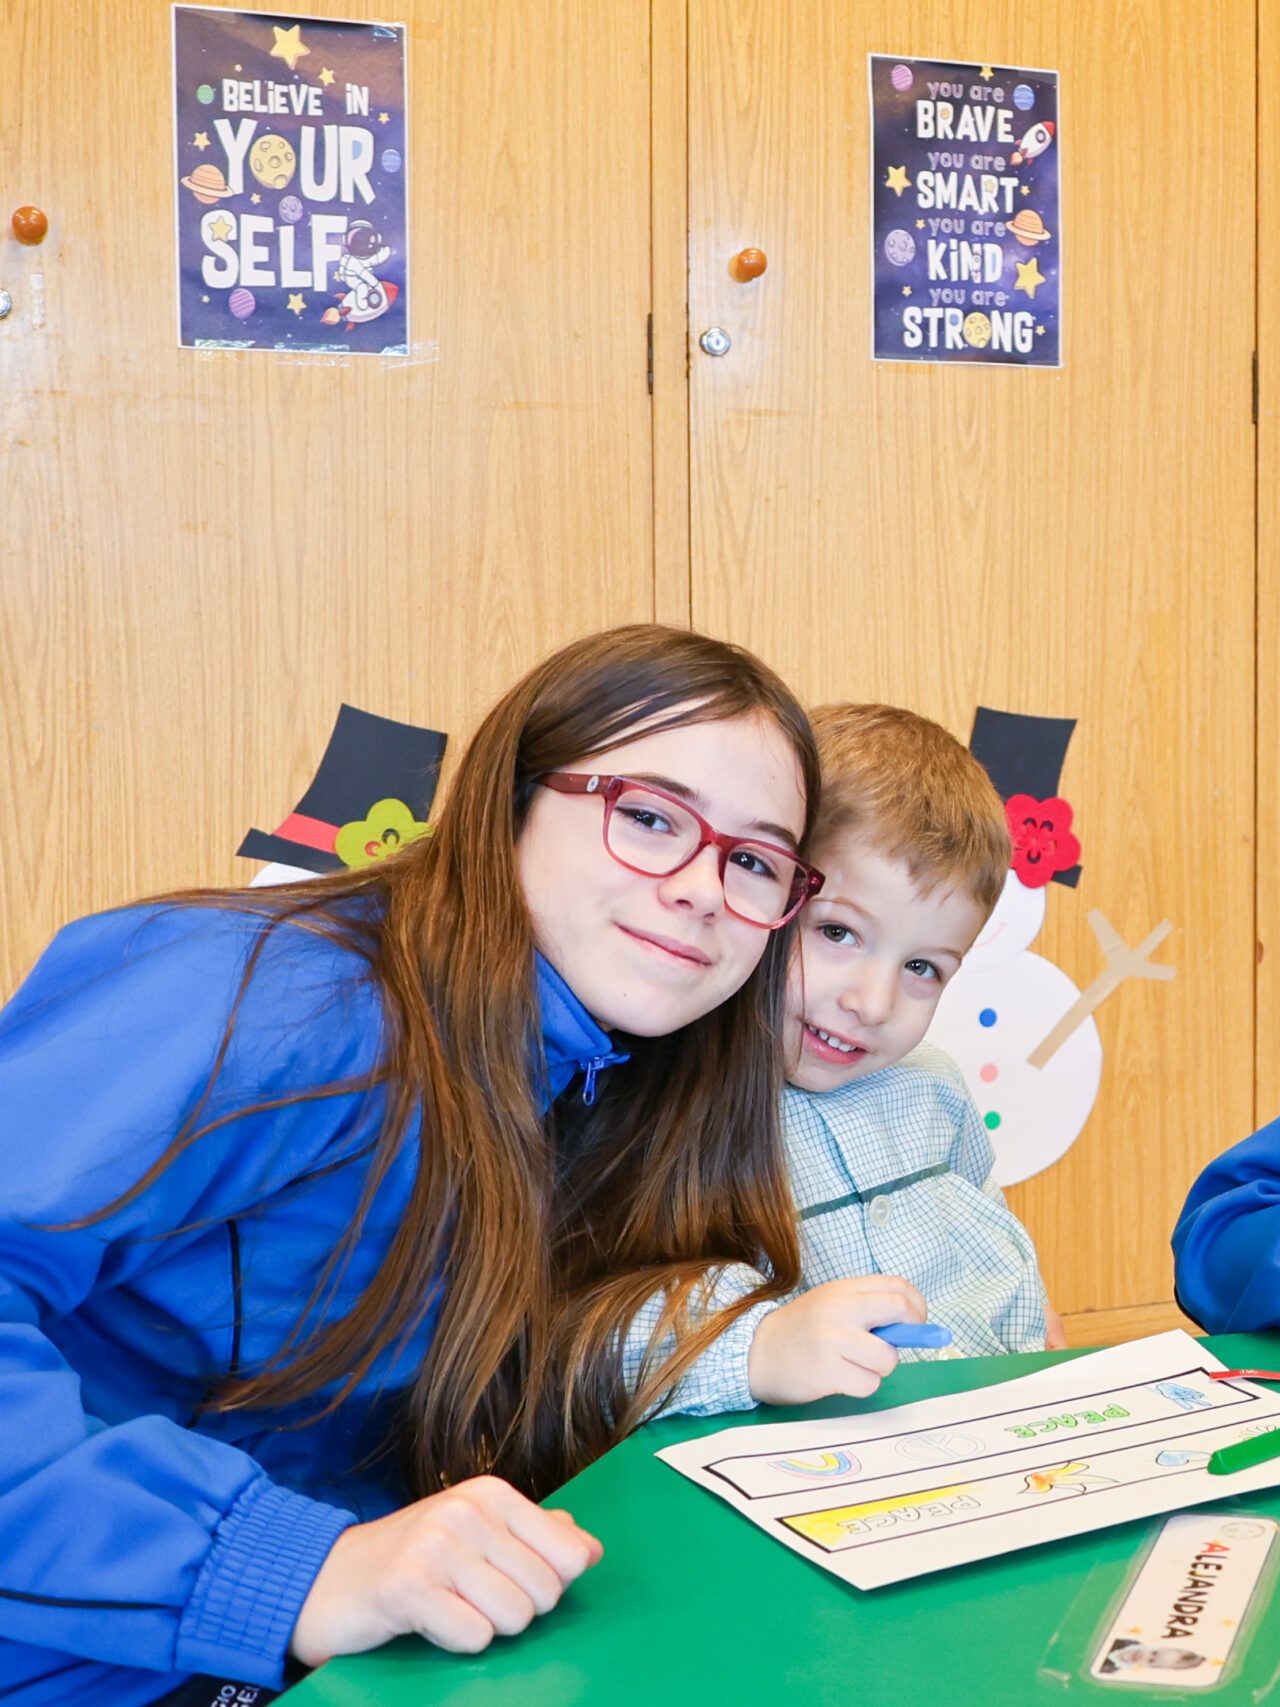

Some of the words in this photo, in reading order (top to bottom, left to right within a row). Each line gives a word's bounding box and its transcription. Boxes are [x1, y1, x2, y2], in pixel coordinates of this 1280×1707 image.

[927, 81, 963, 101] you
[969, 83, 1005, 103] are
[916, 100, 1015, 143] BRAVE
[213, 118, 377, 205] YOUR
[928, 151, 964, 171] you
[970, 154, 1006, 173] are
[916, 170, 1019, 214] SMART
[928, 217, 965, 237] you
[971, 219, 1006, 237] are
[200, 209, 349, 292] SELF
[929, 287, 966, 307] you
[972, 289, 1007, 307] are
[903, 306, 1034, 354] STRONG
[1004, 1403, 1130, 1438] PEACE
[836, 1494, 981, 1534] PEACE
[1161, 1541, 1231, 1638] ALEJANDRA
